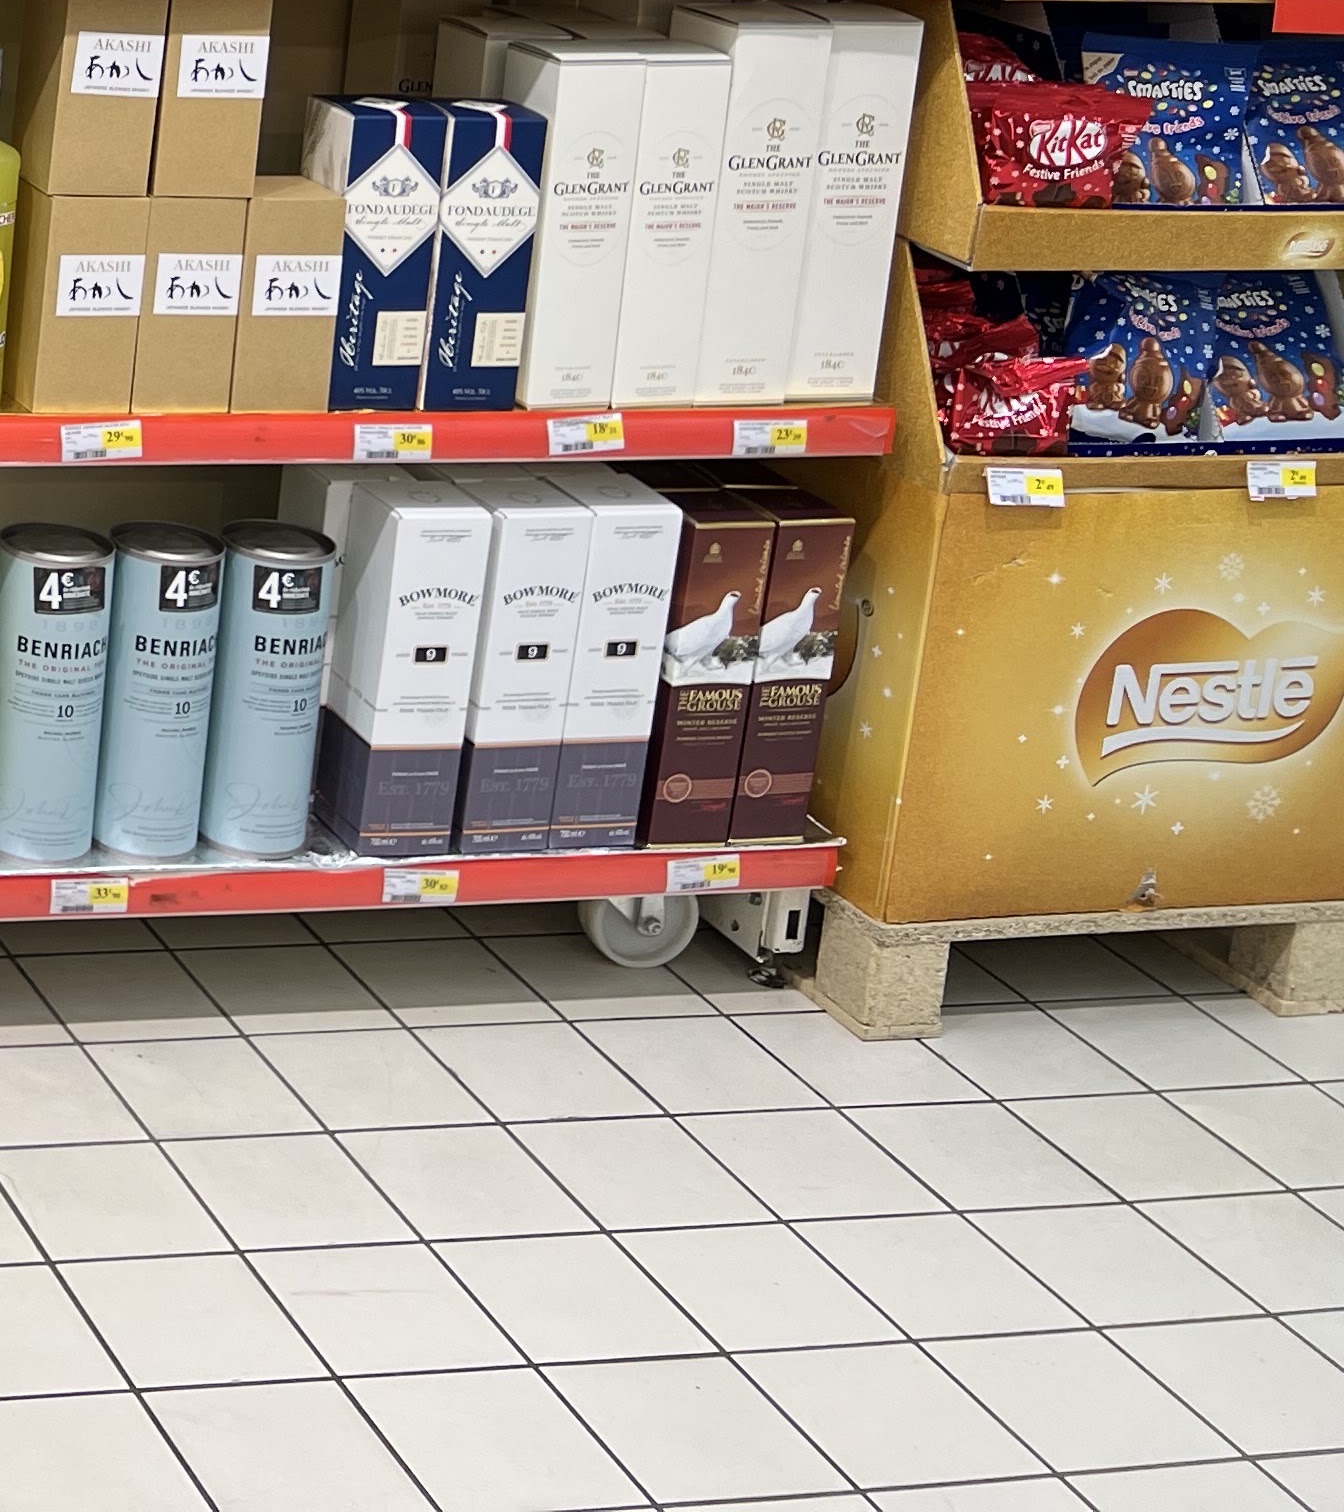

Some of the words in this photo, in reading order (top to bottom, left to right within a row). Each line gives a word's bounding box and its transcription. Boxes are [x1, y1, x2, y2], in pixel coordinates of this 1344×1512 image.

[94, 39, 151, 53] AKASHI
[198, 41, 255, 54] AKASHI
[1034, 119, 1105, 165] KitKat
[173, 259, 231, 272] AKASHI
[398, 588, 479, 607] BOWMORE
[17, 635, 108, 660] BENRIACH
[42, 661, 91, 673] ORIGINAL
[689, 688, 742, 702] FAMOUS
[769, 684, 822, 697] FAMOUS
[56, 704, 74, 718] 10
[175, 702, 190, 715] 10
[686, 698, 741, 712] GROUSE
